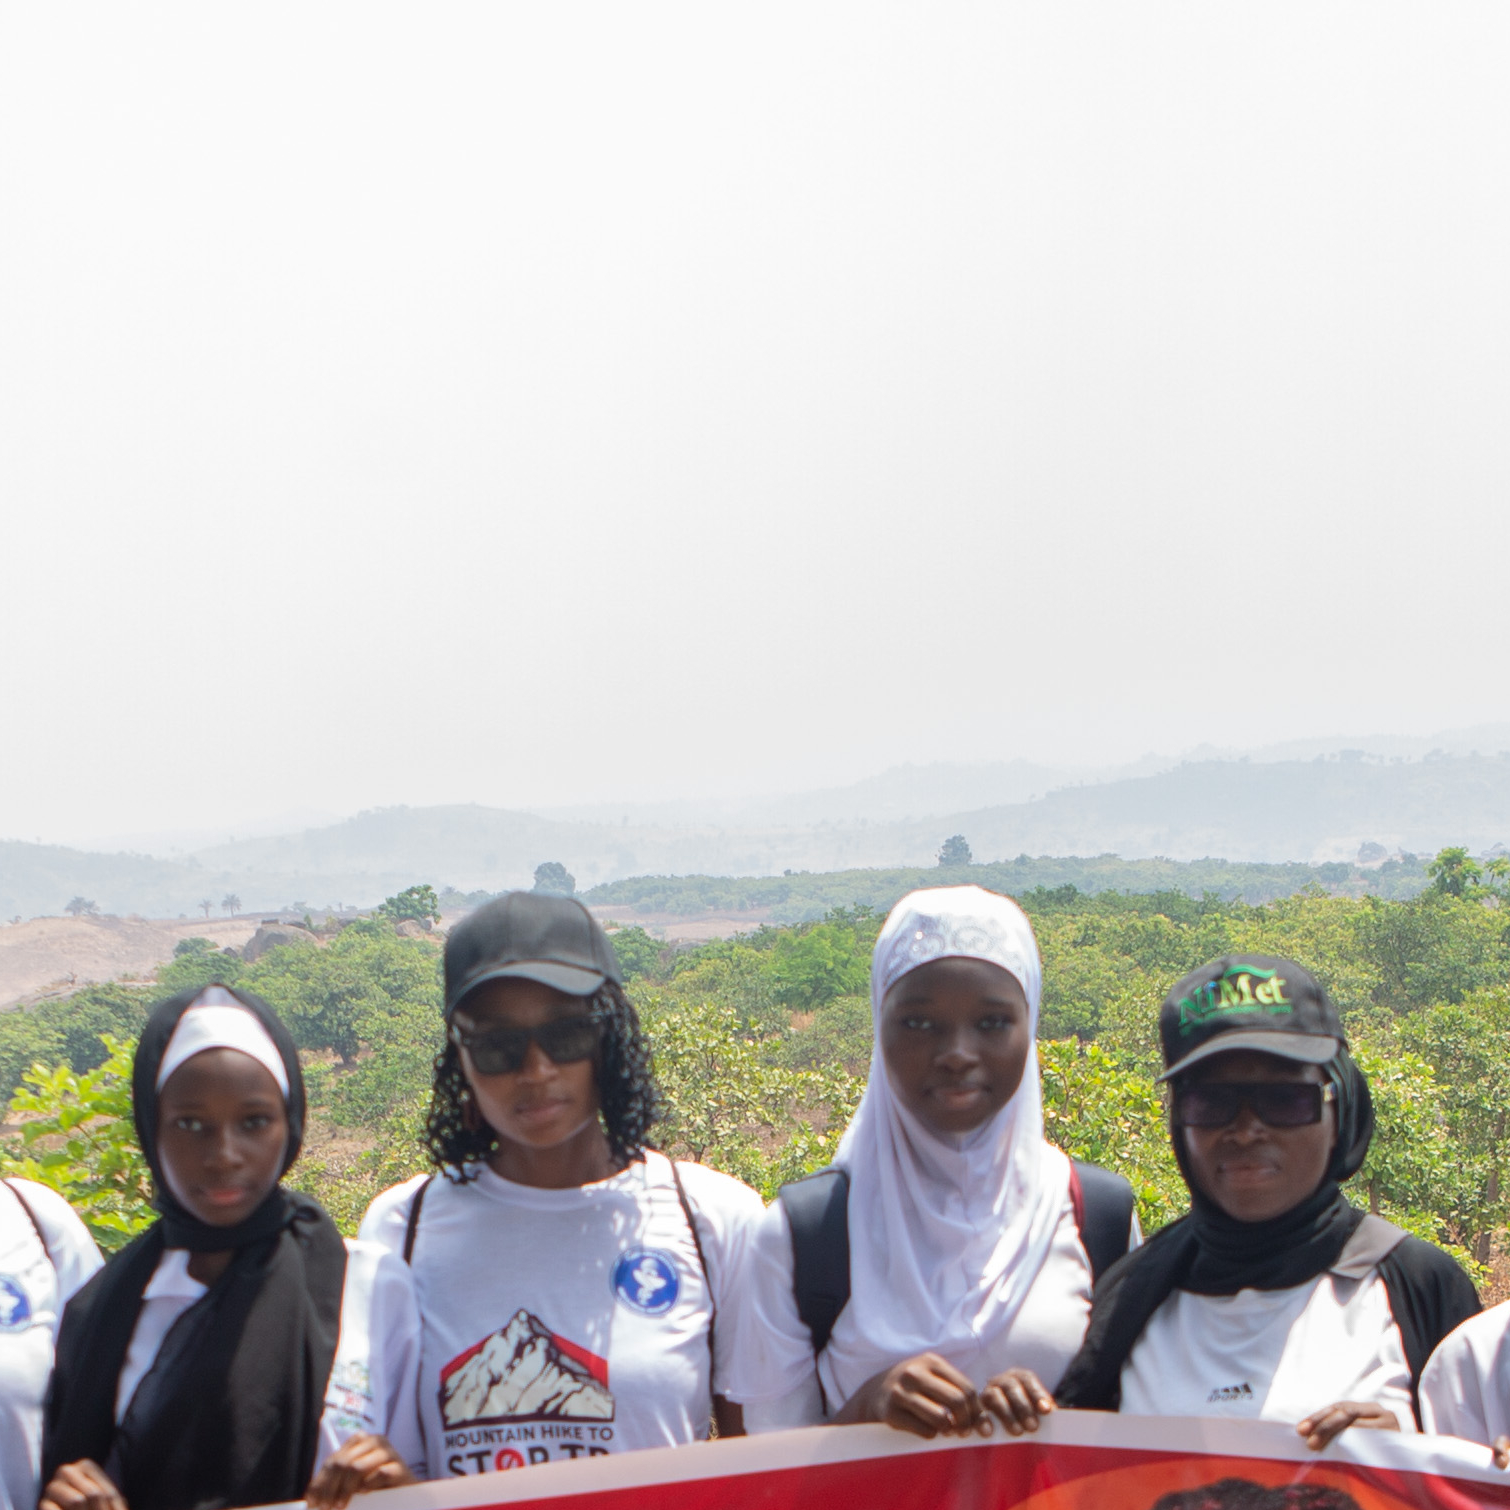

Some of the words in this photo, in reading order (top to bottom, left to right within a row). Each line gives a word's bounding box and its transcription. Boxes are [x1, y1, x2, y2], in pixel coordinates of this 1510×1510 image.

[445, 1426, 535, 1448] MOUNTAIN
[540, 1425, 583, 1440] HIKE
[588, 1427, 613, 1441] TO
